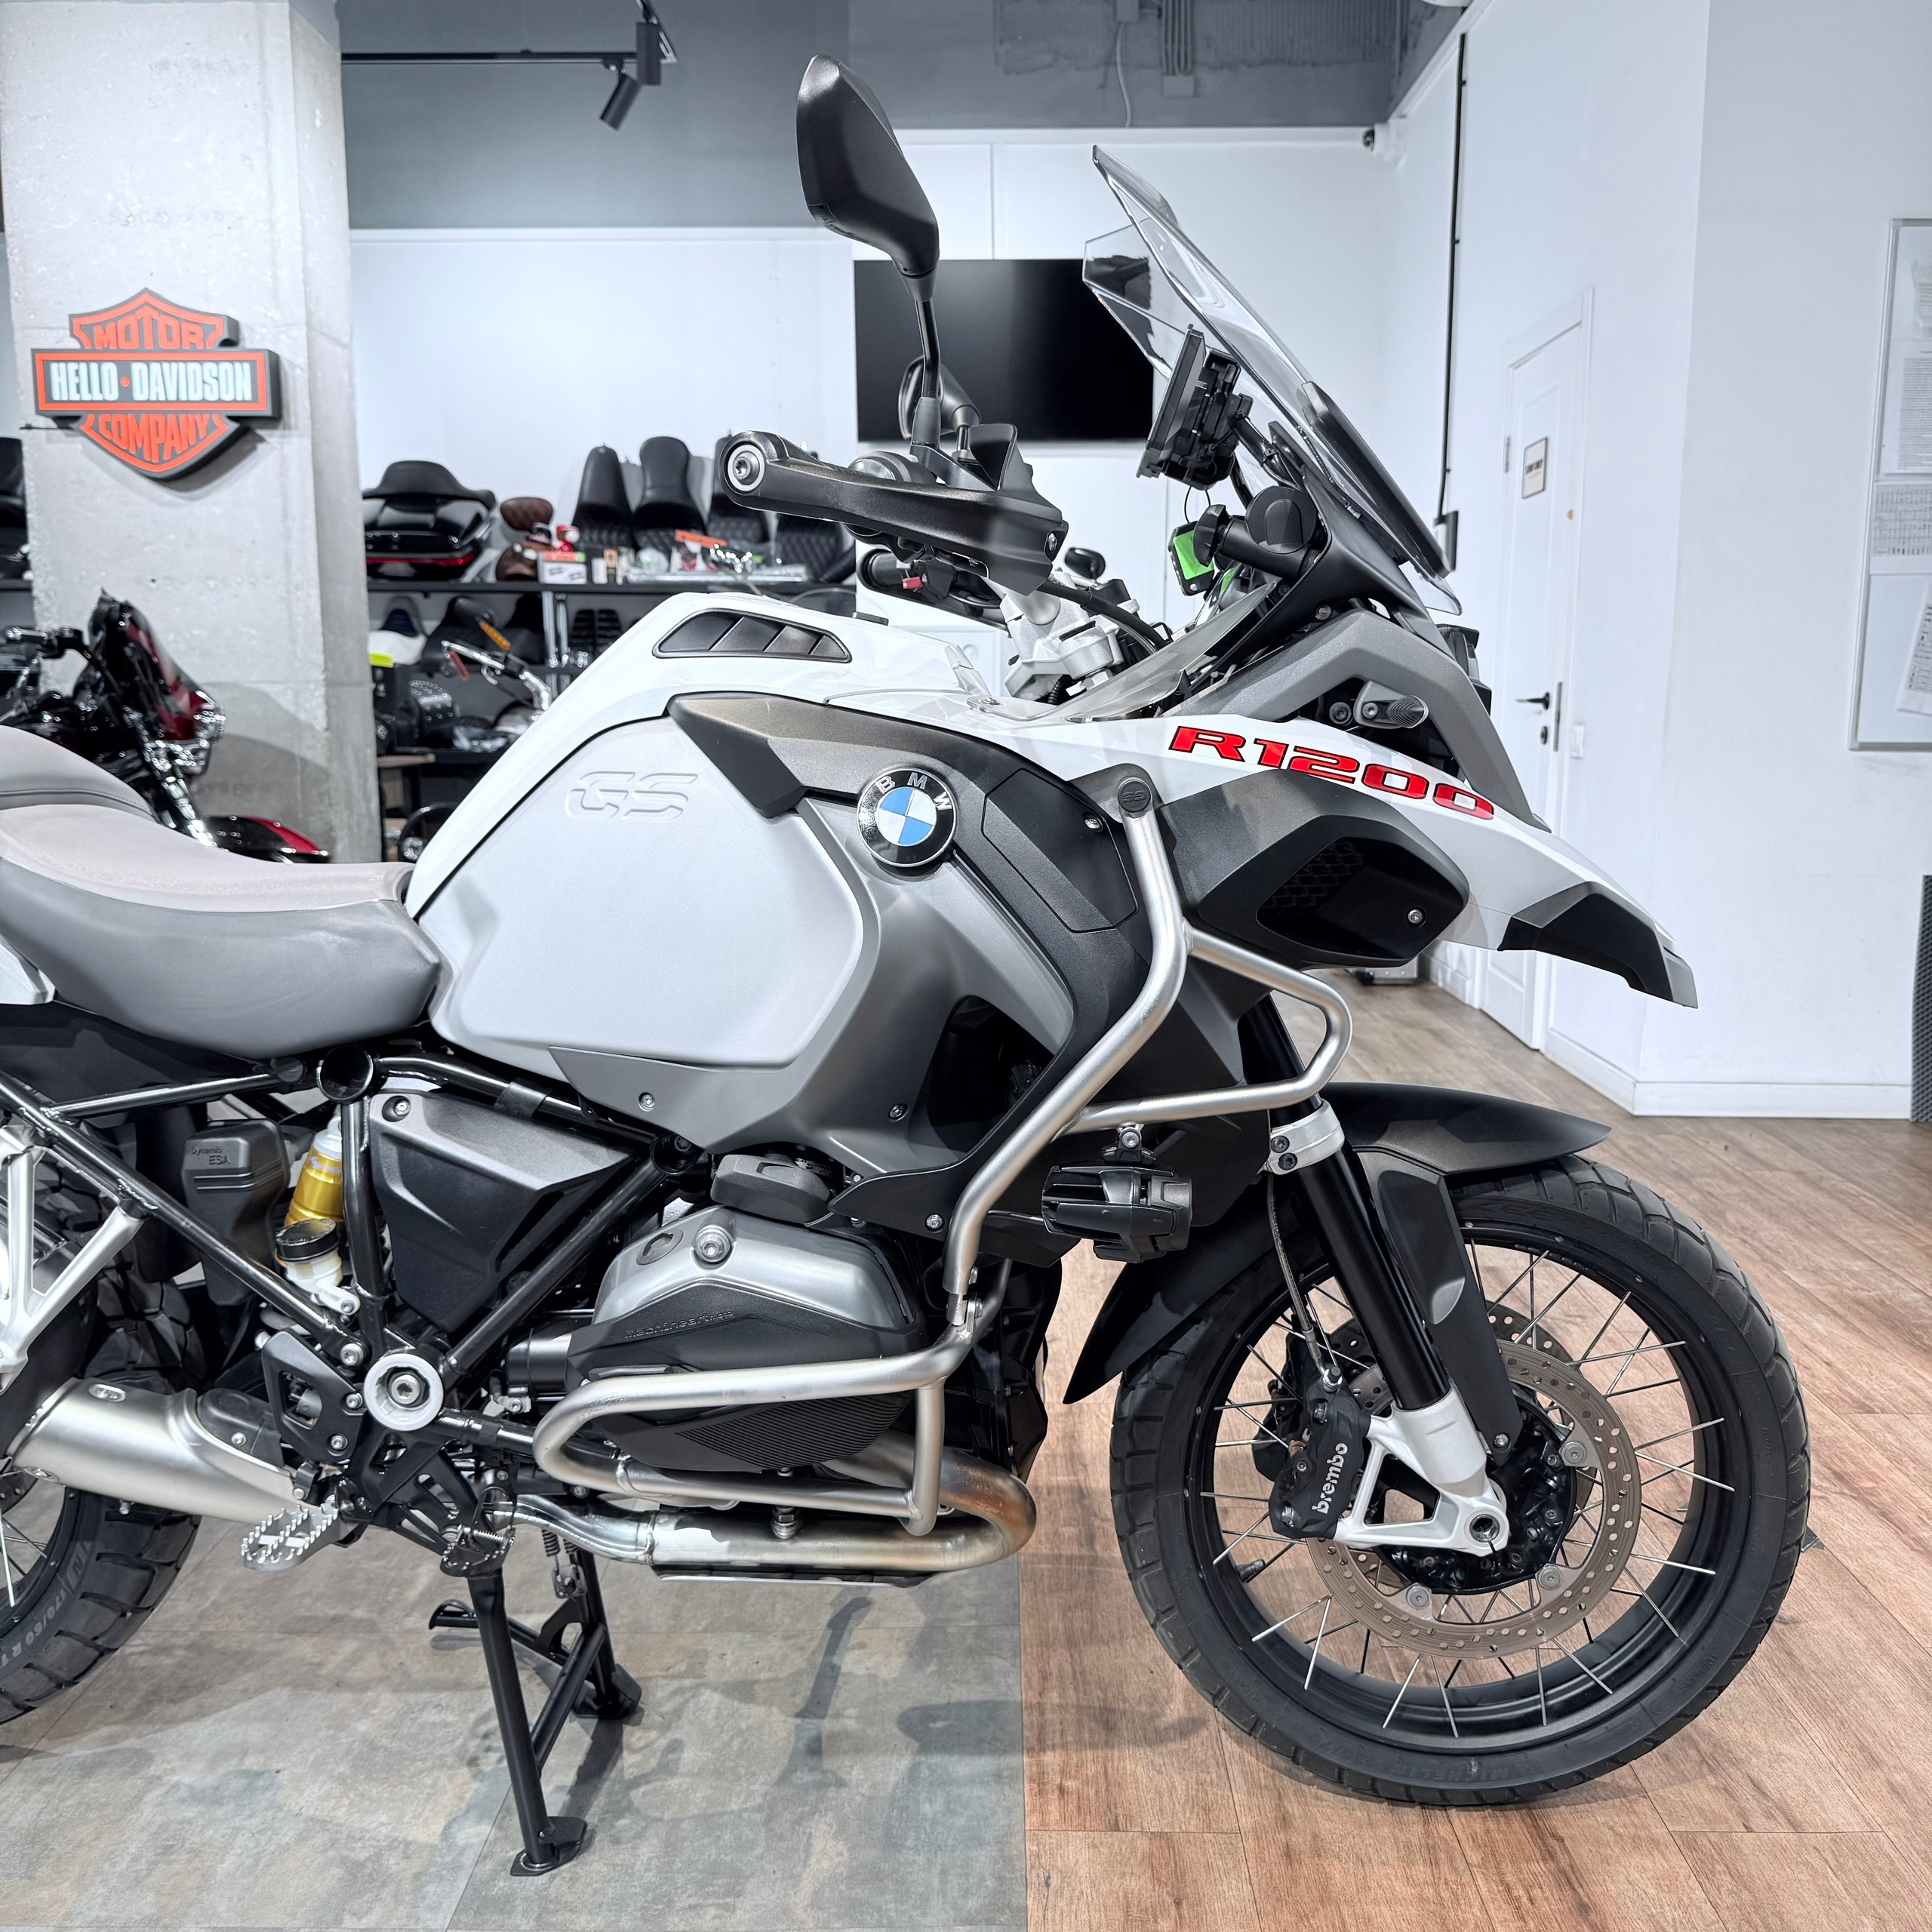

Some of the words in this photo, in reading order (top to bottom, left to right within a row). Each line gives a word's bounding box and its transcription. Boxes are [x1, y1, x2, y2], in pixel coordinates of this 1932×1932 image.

[93, 304, 205, 349] MOTOR
[50, 361, 119, 401] HELLO
[131, 361, 252, 401] DAVIDSON
[98, 413, 211, 463] COMPANY
[875, 771, 952, 811] BMW
[1168, 725, 1494, 820] R1200
[565, 771, 698, 822] GS
[191, 1146, 223, 1156] Dynamic
[208, 1155, 231, 1165] ESA
[1312, 1442, 1348, 1514] brembo
